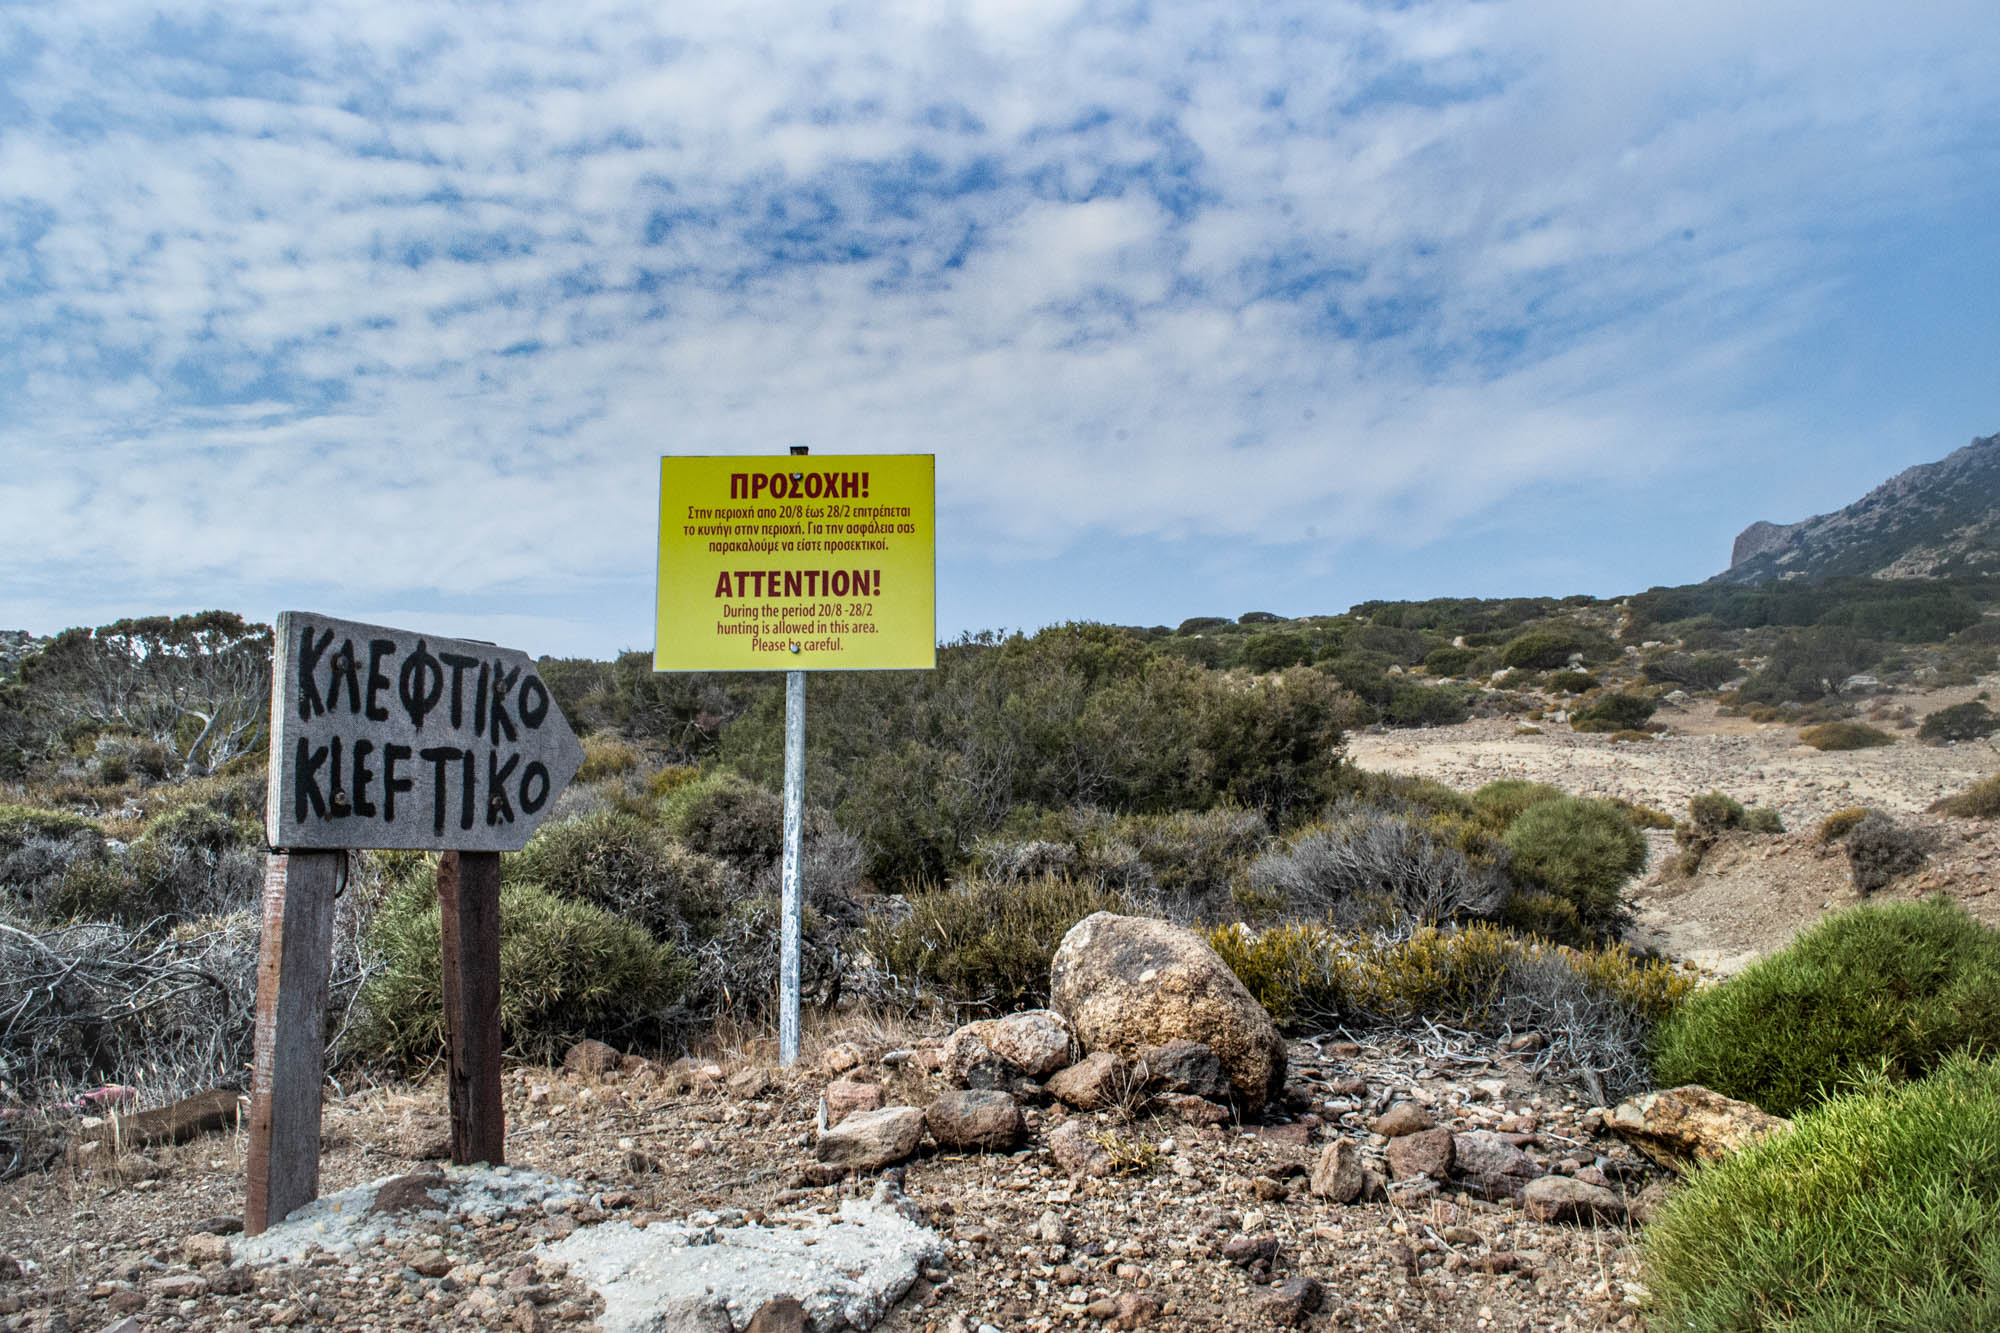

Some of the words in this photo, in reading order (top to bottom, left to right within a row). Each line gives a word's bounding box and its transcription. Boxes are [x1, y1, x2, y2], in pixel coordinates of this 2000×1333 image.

[730, 472, 869, 499] ΠΡΟΣΟΧΗ!
[688, 505, 713, 519] Στην
[715, 506, 754, 522] περιοχή
[757, 508, 777, 519] απο
[779, 505, 803, 519] 20/8
[805, 504, 824, 518] έως
[827, 504, 850, 518] 28/2
[853, 504, 911, 520] επιτρέπεται
[683, 526, 696, 536] το
[697, 522, 732, 537] κυνήγι
[734, 524, 759, 535] στην
[761, 522, 805, 538] περιοχή.
[808, 521, 823, 534] Για
[825, 524, 844, 535] την
[846, 520, 894, 537] ασφάλεια
[897, 523, 915, 534] σας
[709, 539, 779, 555] παρακαλούμε
[781, 542, 794, 552] να
[797, 538, 821, 552] είστε
[824, 537, 889, 554] προσεκτικοί.
[714, 569, 881, 598] ATTENTION!
[723, 604, 759, 620] During
[761, 604, 779, 617] the
[781, 603, 816, 622] period
[818, 603, 842, 617] 20/8
[717, 621, 759, 637] hunting
[762, 621, 770, 634] is
[772, 620, 814, 634] allowed
[817, 621, 827, 634] in
[830, 620, 849, 634] this
[852, 623, 879, 634] area.
[751, 638, 786, 652] Please
[804, 637, 844, 652] careful.
[299, 626, 549, 746] ΚΛΕΦΤΙΚΟ
[294, 735, 550, 837] KLEFTIKO
